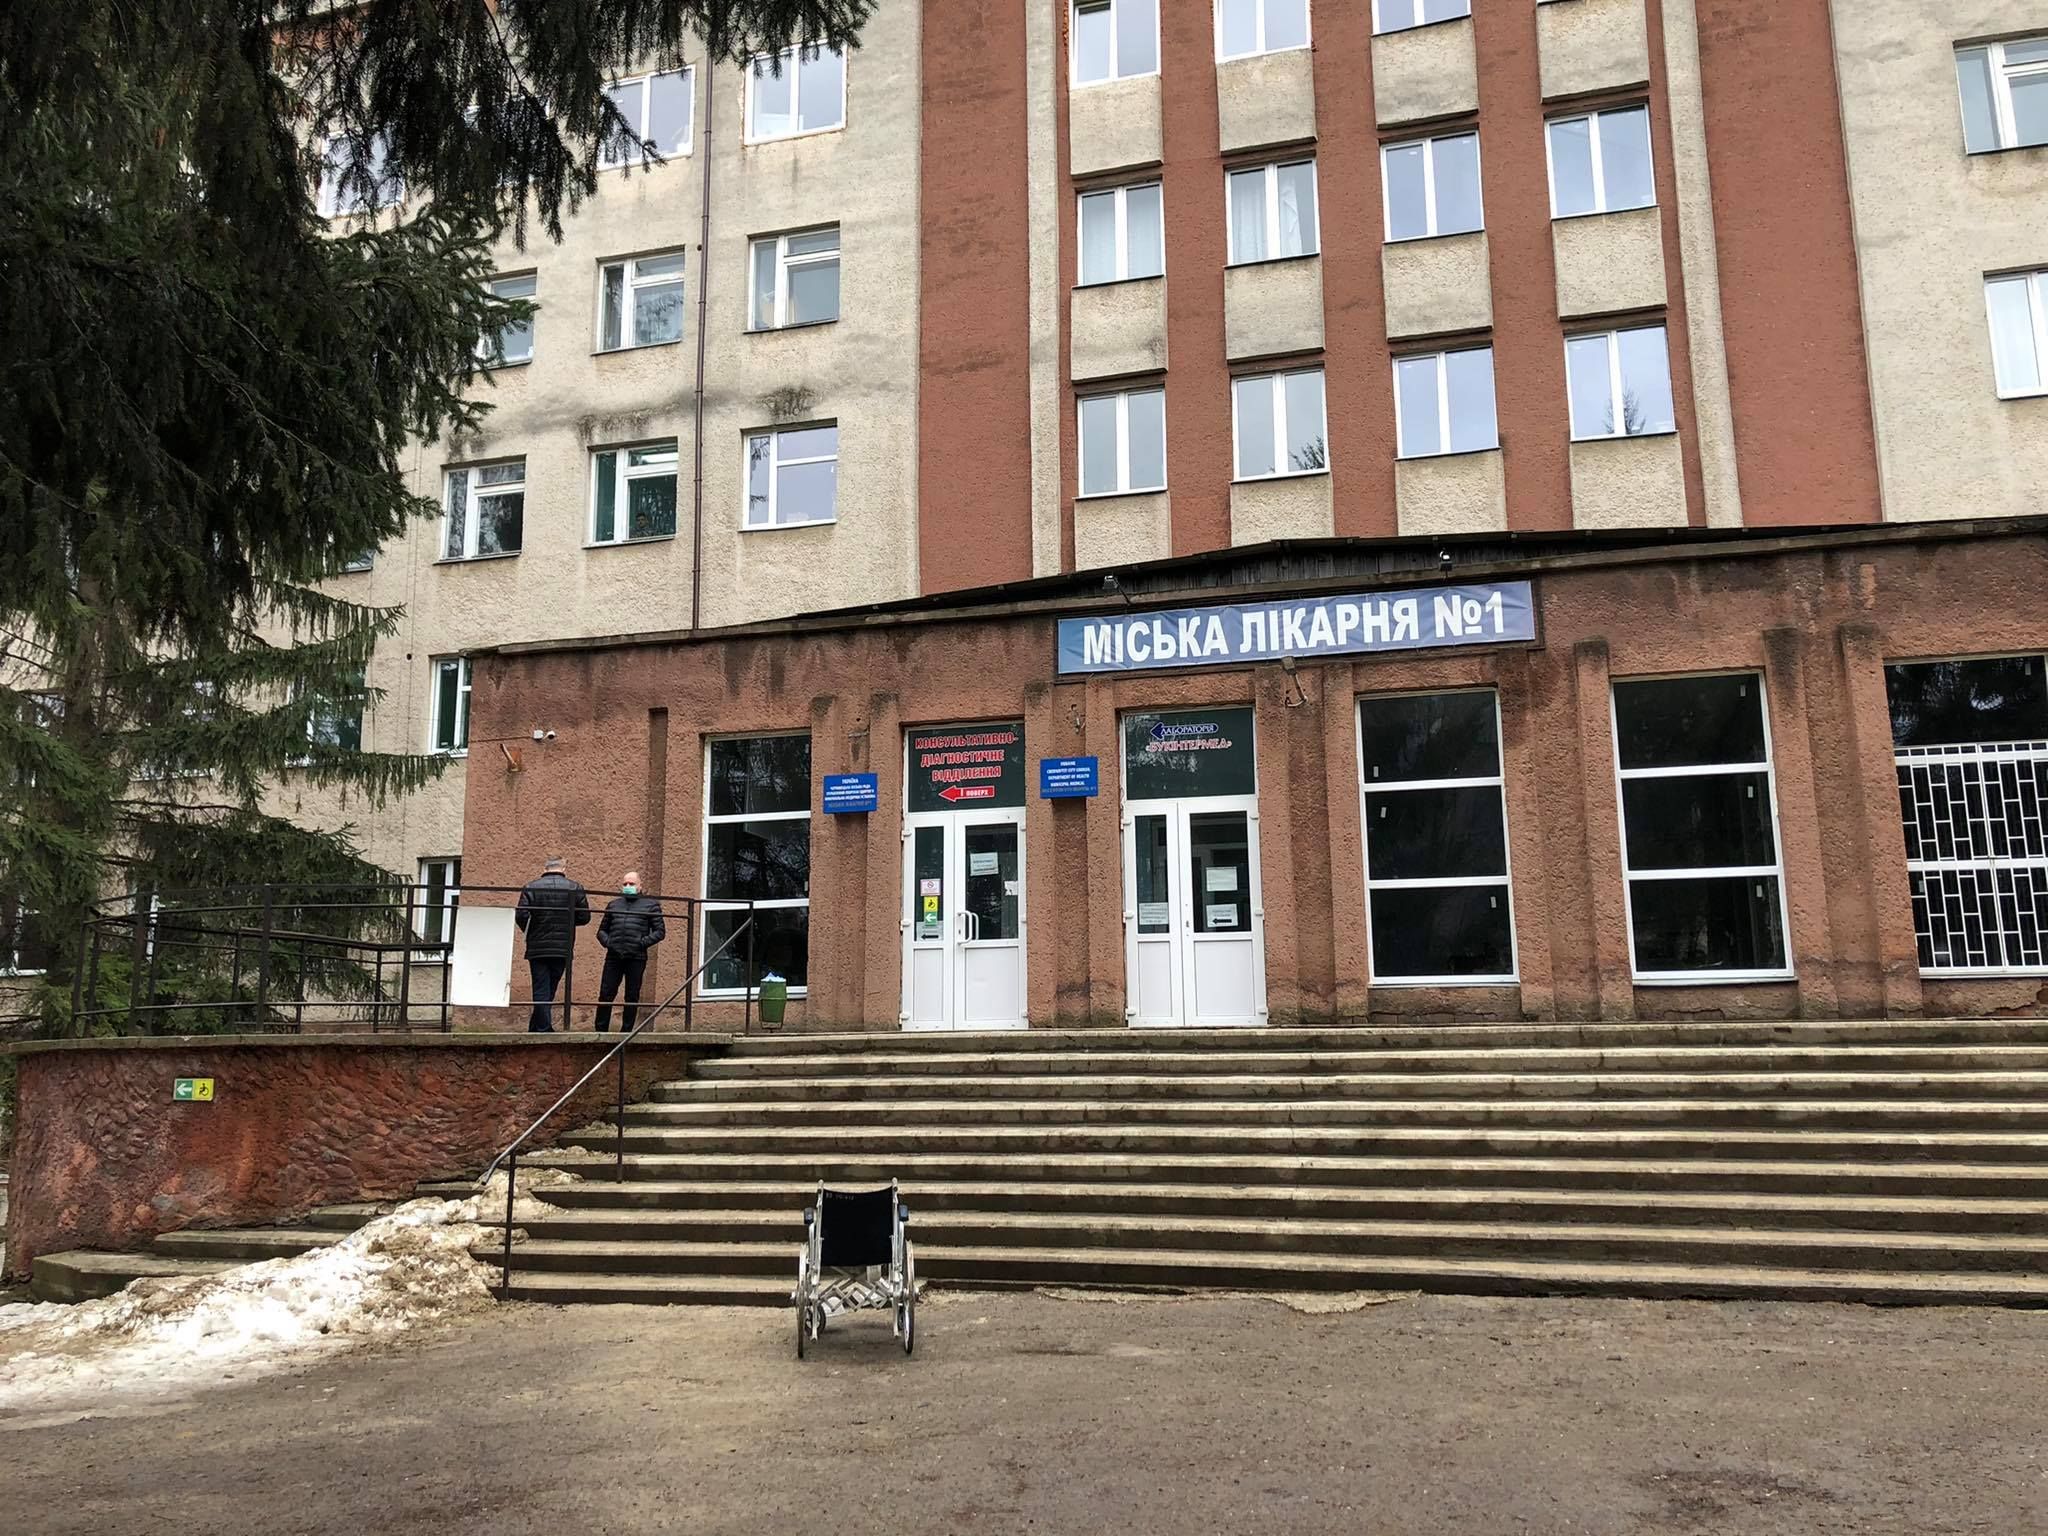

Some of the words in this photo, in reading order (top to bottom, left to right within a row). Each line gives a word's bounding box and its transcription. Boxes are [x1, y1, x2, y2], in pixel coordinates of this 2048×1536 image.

[1083, 615, 1230, 665] МІСЬКА
[1239, 598, 1419, 654] ЛІКАРНЯ
[1433, 591, 1504, 638] №1
[915, 732, 1019, 749] КОНСУЛЬТАТИВНО-
[920, 750, 1005, 768] ДІАГНОСТИЧНЕ
[932, 765, 1001, 782] ВІДДІЛЕННЯ
